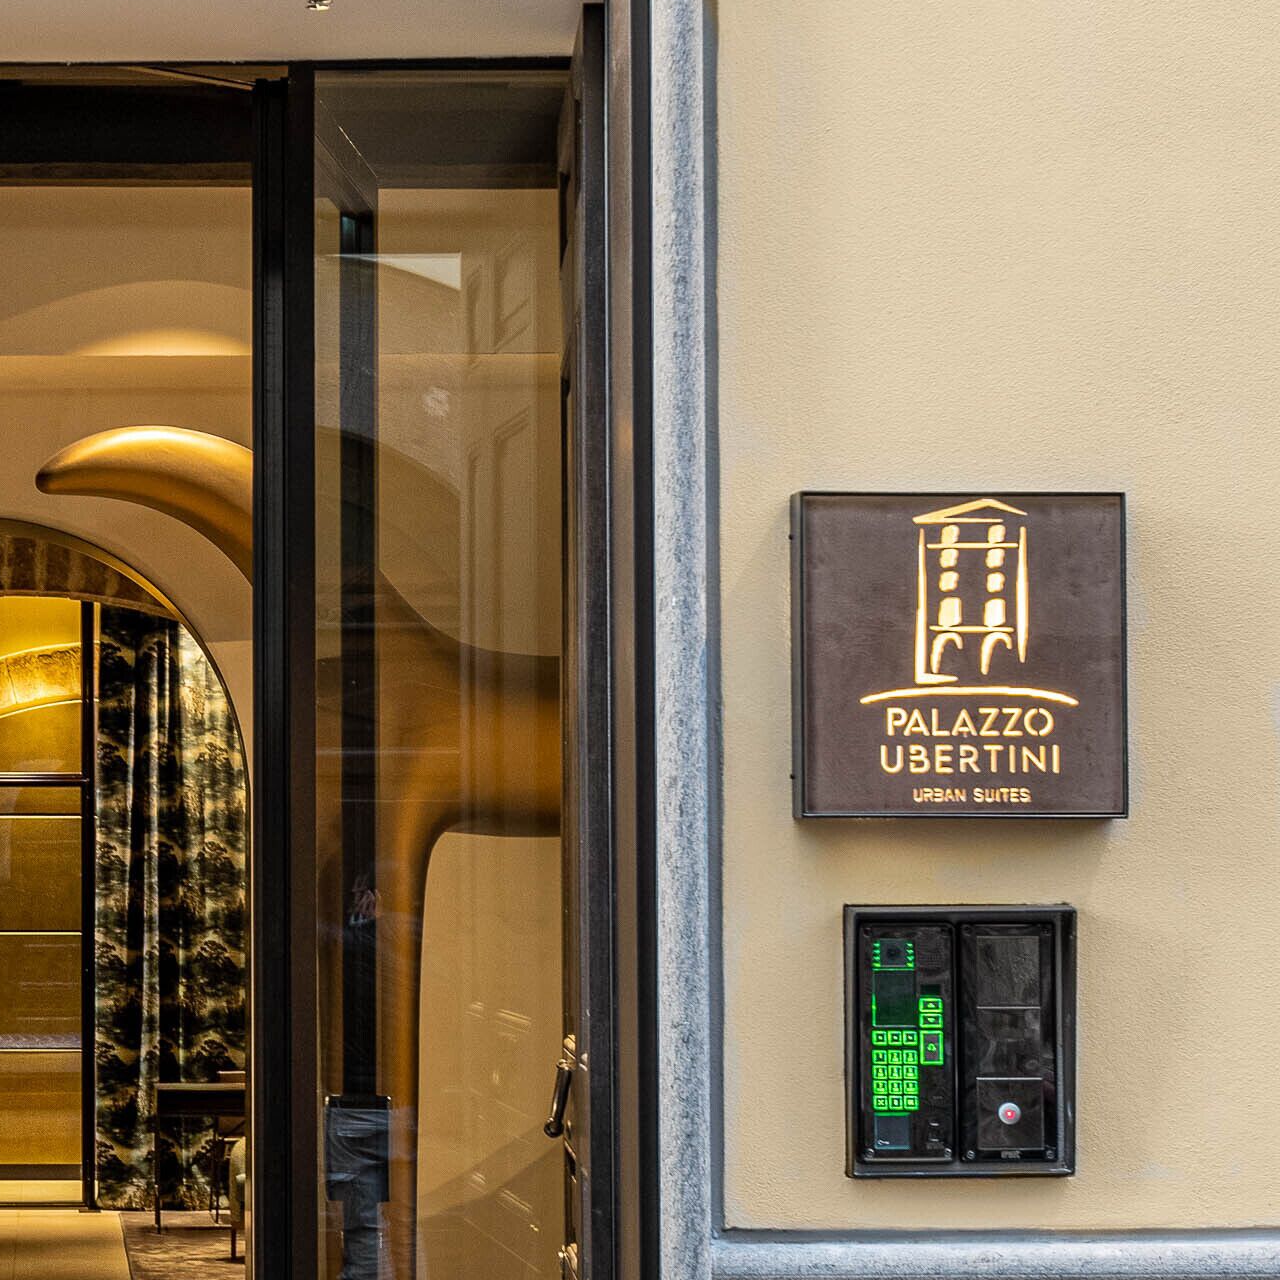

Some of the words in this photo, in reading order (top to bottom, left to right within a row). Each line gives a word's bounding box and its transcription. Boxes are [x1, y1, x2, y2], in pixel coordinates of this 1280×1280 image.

[886, 707, 1054, 737] PALAZZO
[880, 744, 1061, 774] UBERTINI
[912, 787, 967, 803] URBAN
[972, 787, 1032, 803] SUITES
